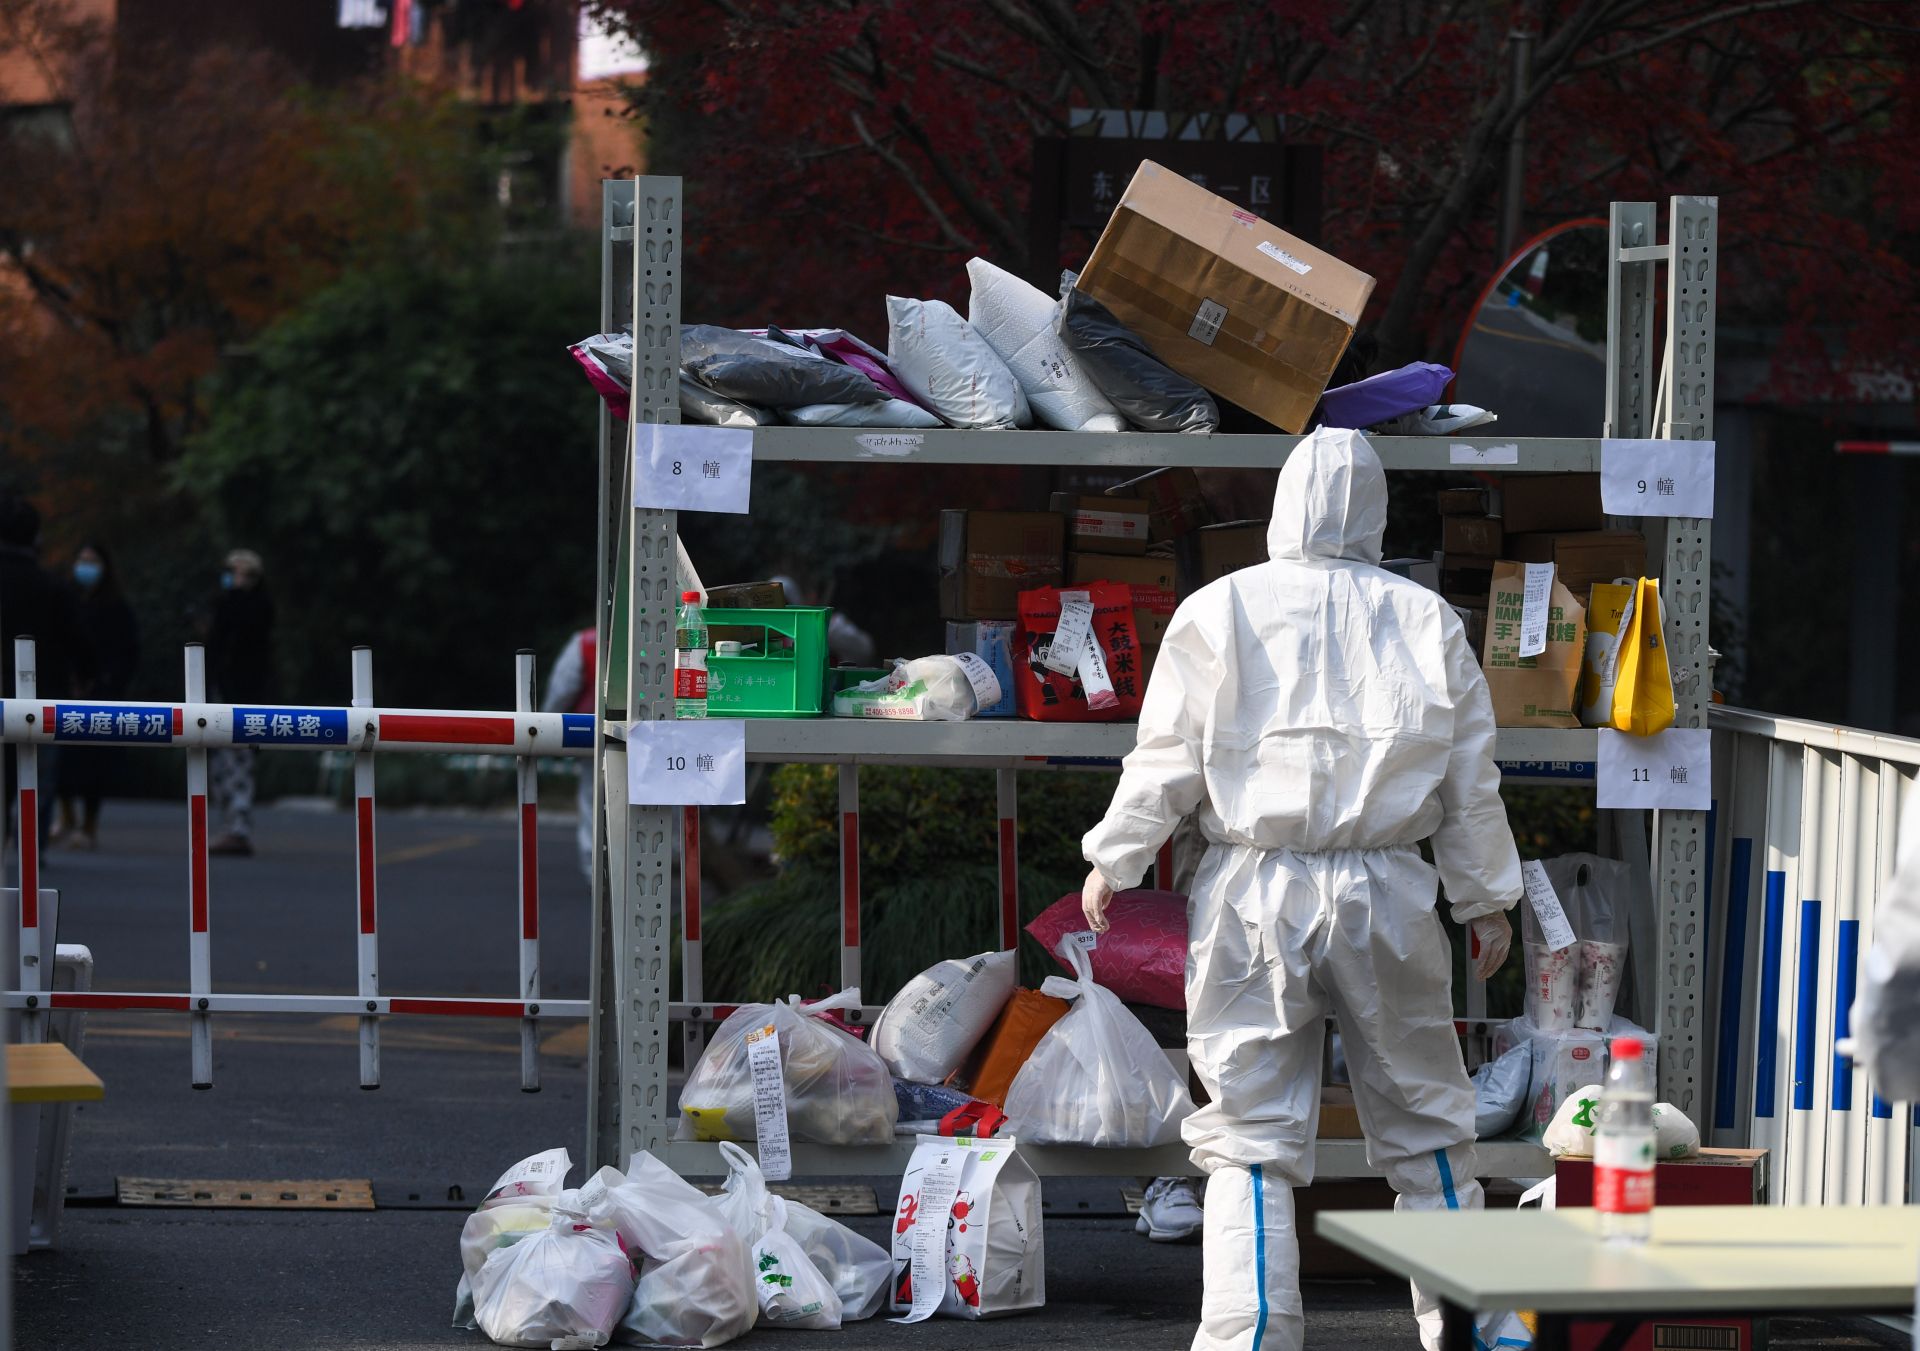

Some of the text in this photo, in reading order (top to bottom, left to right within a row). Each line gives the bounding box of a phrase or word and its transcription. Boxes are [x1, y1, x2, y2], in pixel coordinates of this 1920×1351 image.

[672, 459, 721, 479] 8 幢
[1637, 477, 1675, 497] 9 幢
[1494, 623, 1576, 642] 手烤
[1107, 621, 1137, 697] 大鼓米线
[61, 710, 168, 735] 家庭情况
[243, 714, 335, 739] 要保密。
[666, 753, 715, 772] 10 幢
[1631, 765, 1688, 784] 11 幢
